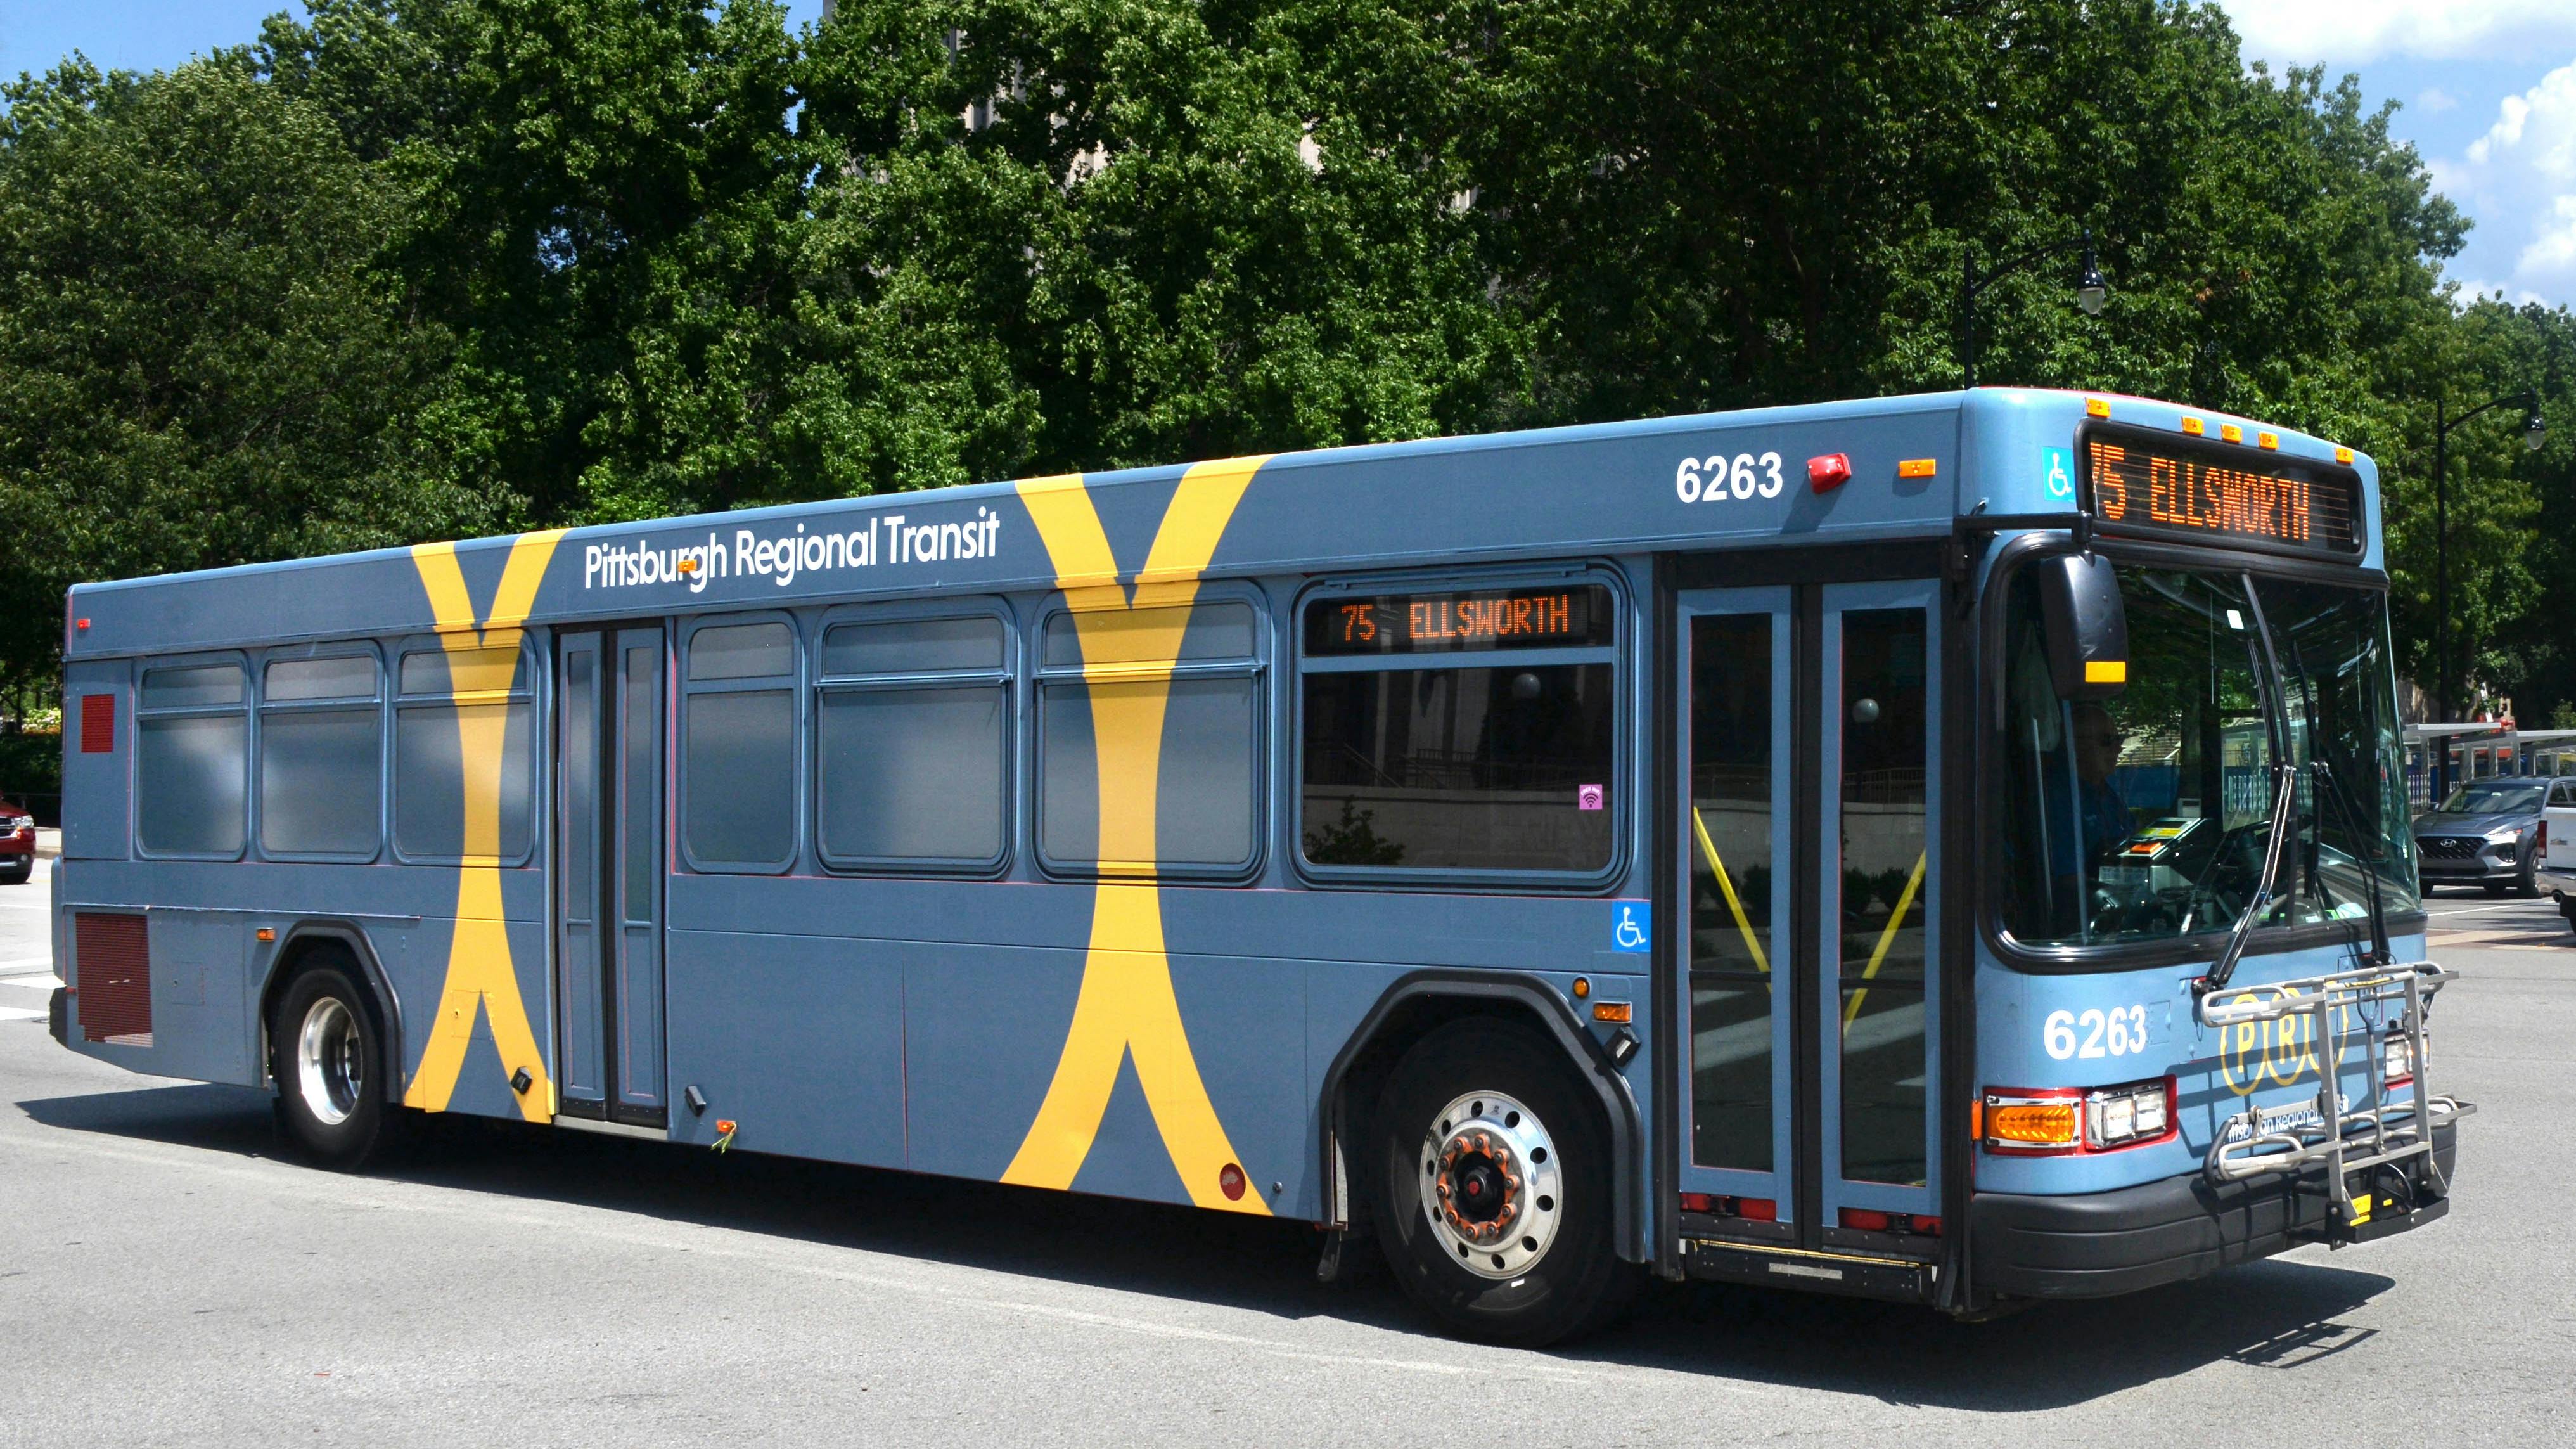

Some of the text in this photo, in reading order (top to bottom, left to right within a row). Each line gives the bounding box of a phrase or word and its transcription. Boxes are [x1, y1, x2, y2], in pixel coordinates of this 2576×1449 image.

[1676, 451, 1783, 503] 6263
[2151, 457, 2309, 541] ELLSWORTH
[586, 506, 1000, 593] Pittsburgh Regional Transit
[1341, 594, 1568, 641] 75 ELLSWORTH
[2044, 1005, 2146, 1060] 6263
